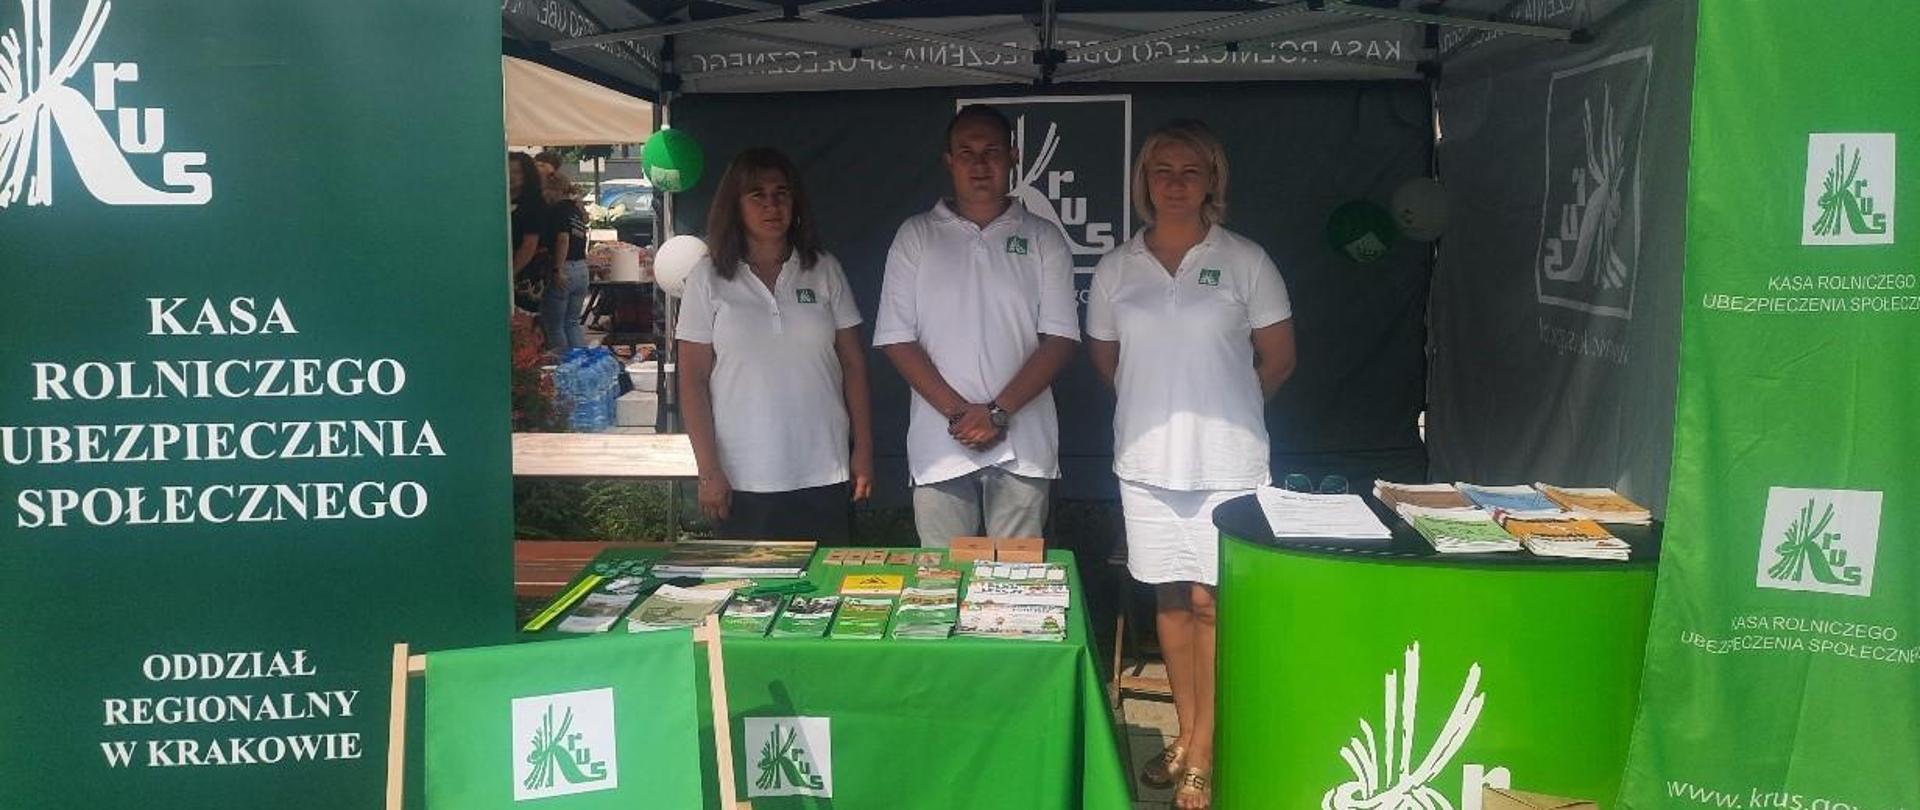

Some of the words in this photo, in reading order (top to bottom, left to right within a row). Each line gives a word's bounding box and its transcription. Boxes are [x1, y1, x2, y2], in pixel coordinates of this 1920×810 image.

[1768, 276, 1814, 292] KASA
[1818, 274, 1916, 290] ROLNICZEGO
[148, 297, 297, 335] KASA
[1702, 294, 1846, 312] UBEZPIECZENIA
[33, 358, 406, 400] ROLNICZEGO
[0, 420, 446, 465] UBEZPIECZENIA
[18, 481, 428, 528] SPOŁECZNEGO
[1773, 615, 1898, 642] ROLNICZEGO
[143, 649, 316, 681] ODDZIAŁ
[102, 690, 360, 726] REGIONALNY
[101, 741, 137, 768] W
[147, 732, 362, 767] KRAKOWIE
